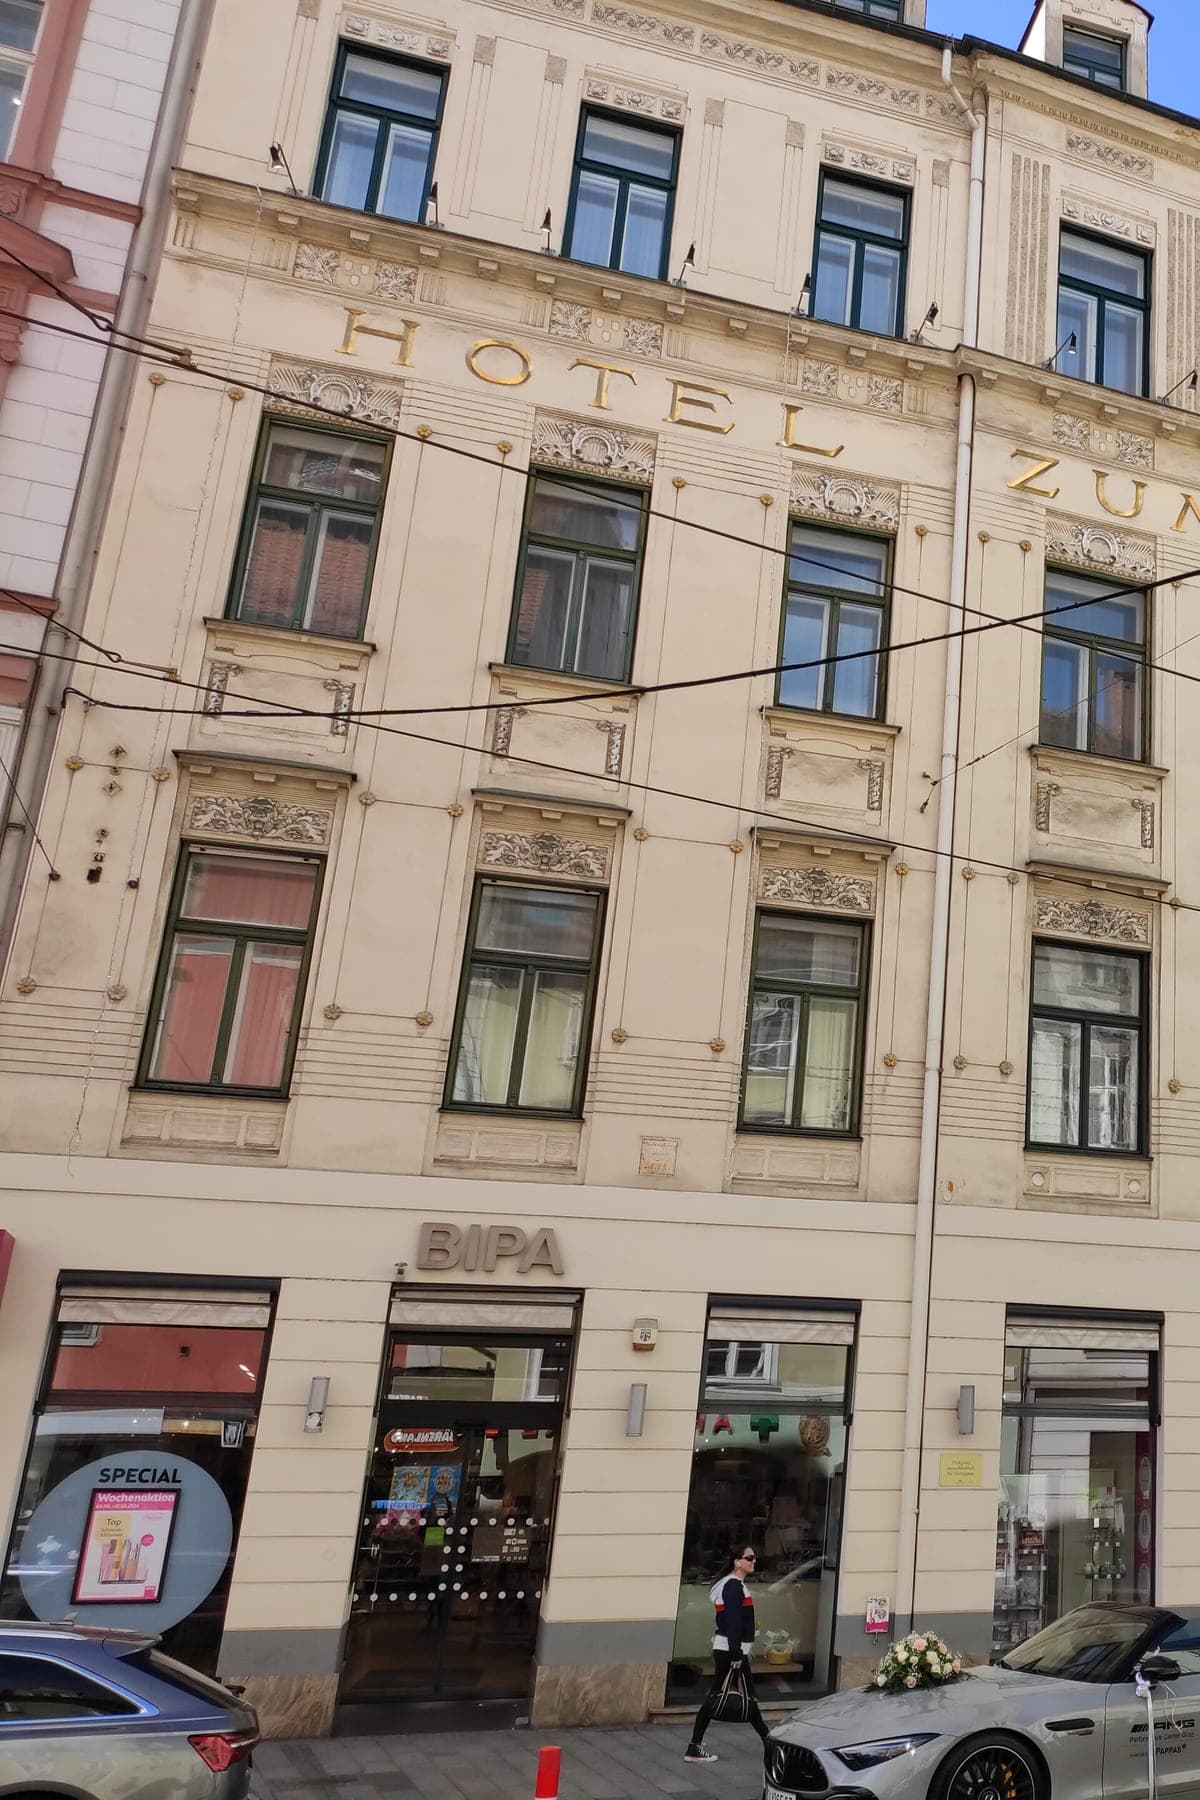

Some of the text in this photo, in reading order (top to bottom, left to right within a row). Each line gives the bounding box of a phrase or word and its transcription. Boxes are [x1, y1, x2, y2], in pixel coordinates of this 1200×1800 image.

[335, 307, 844, 458] HOTEL
[416, 1222, 565, 1275] BIPA
[98, 1467, 182, 1484] SPECIAL
[98, 1492, 175, 1503] Wochenaktion
[106, 1518, 122, 1527] Top
